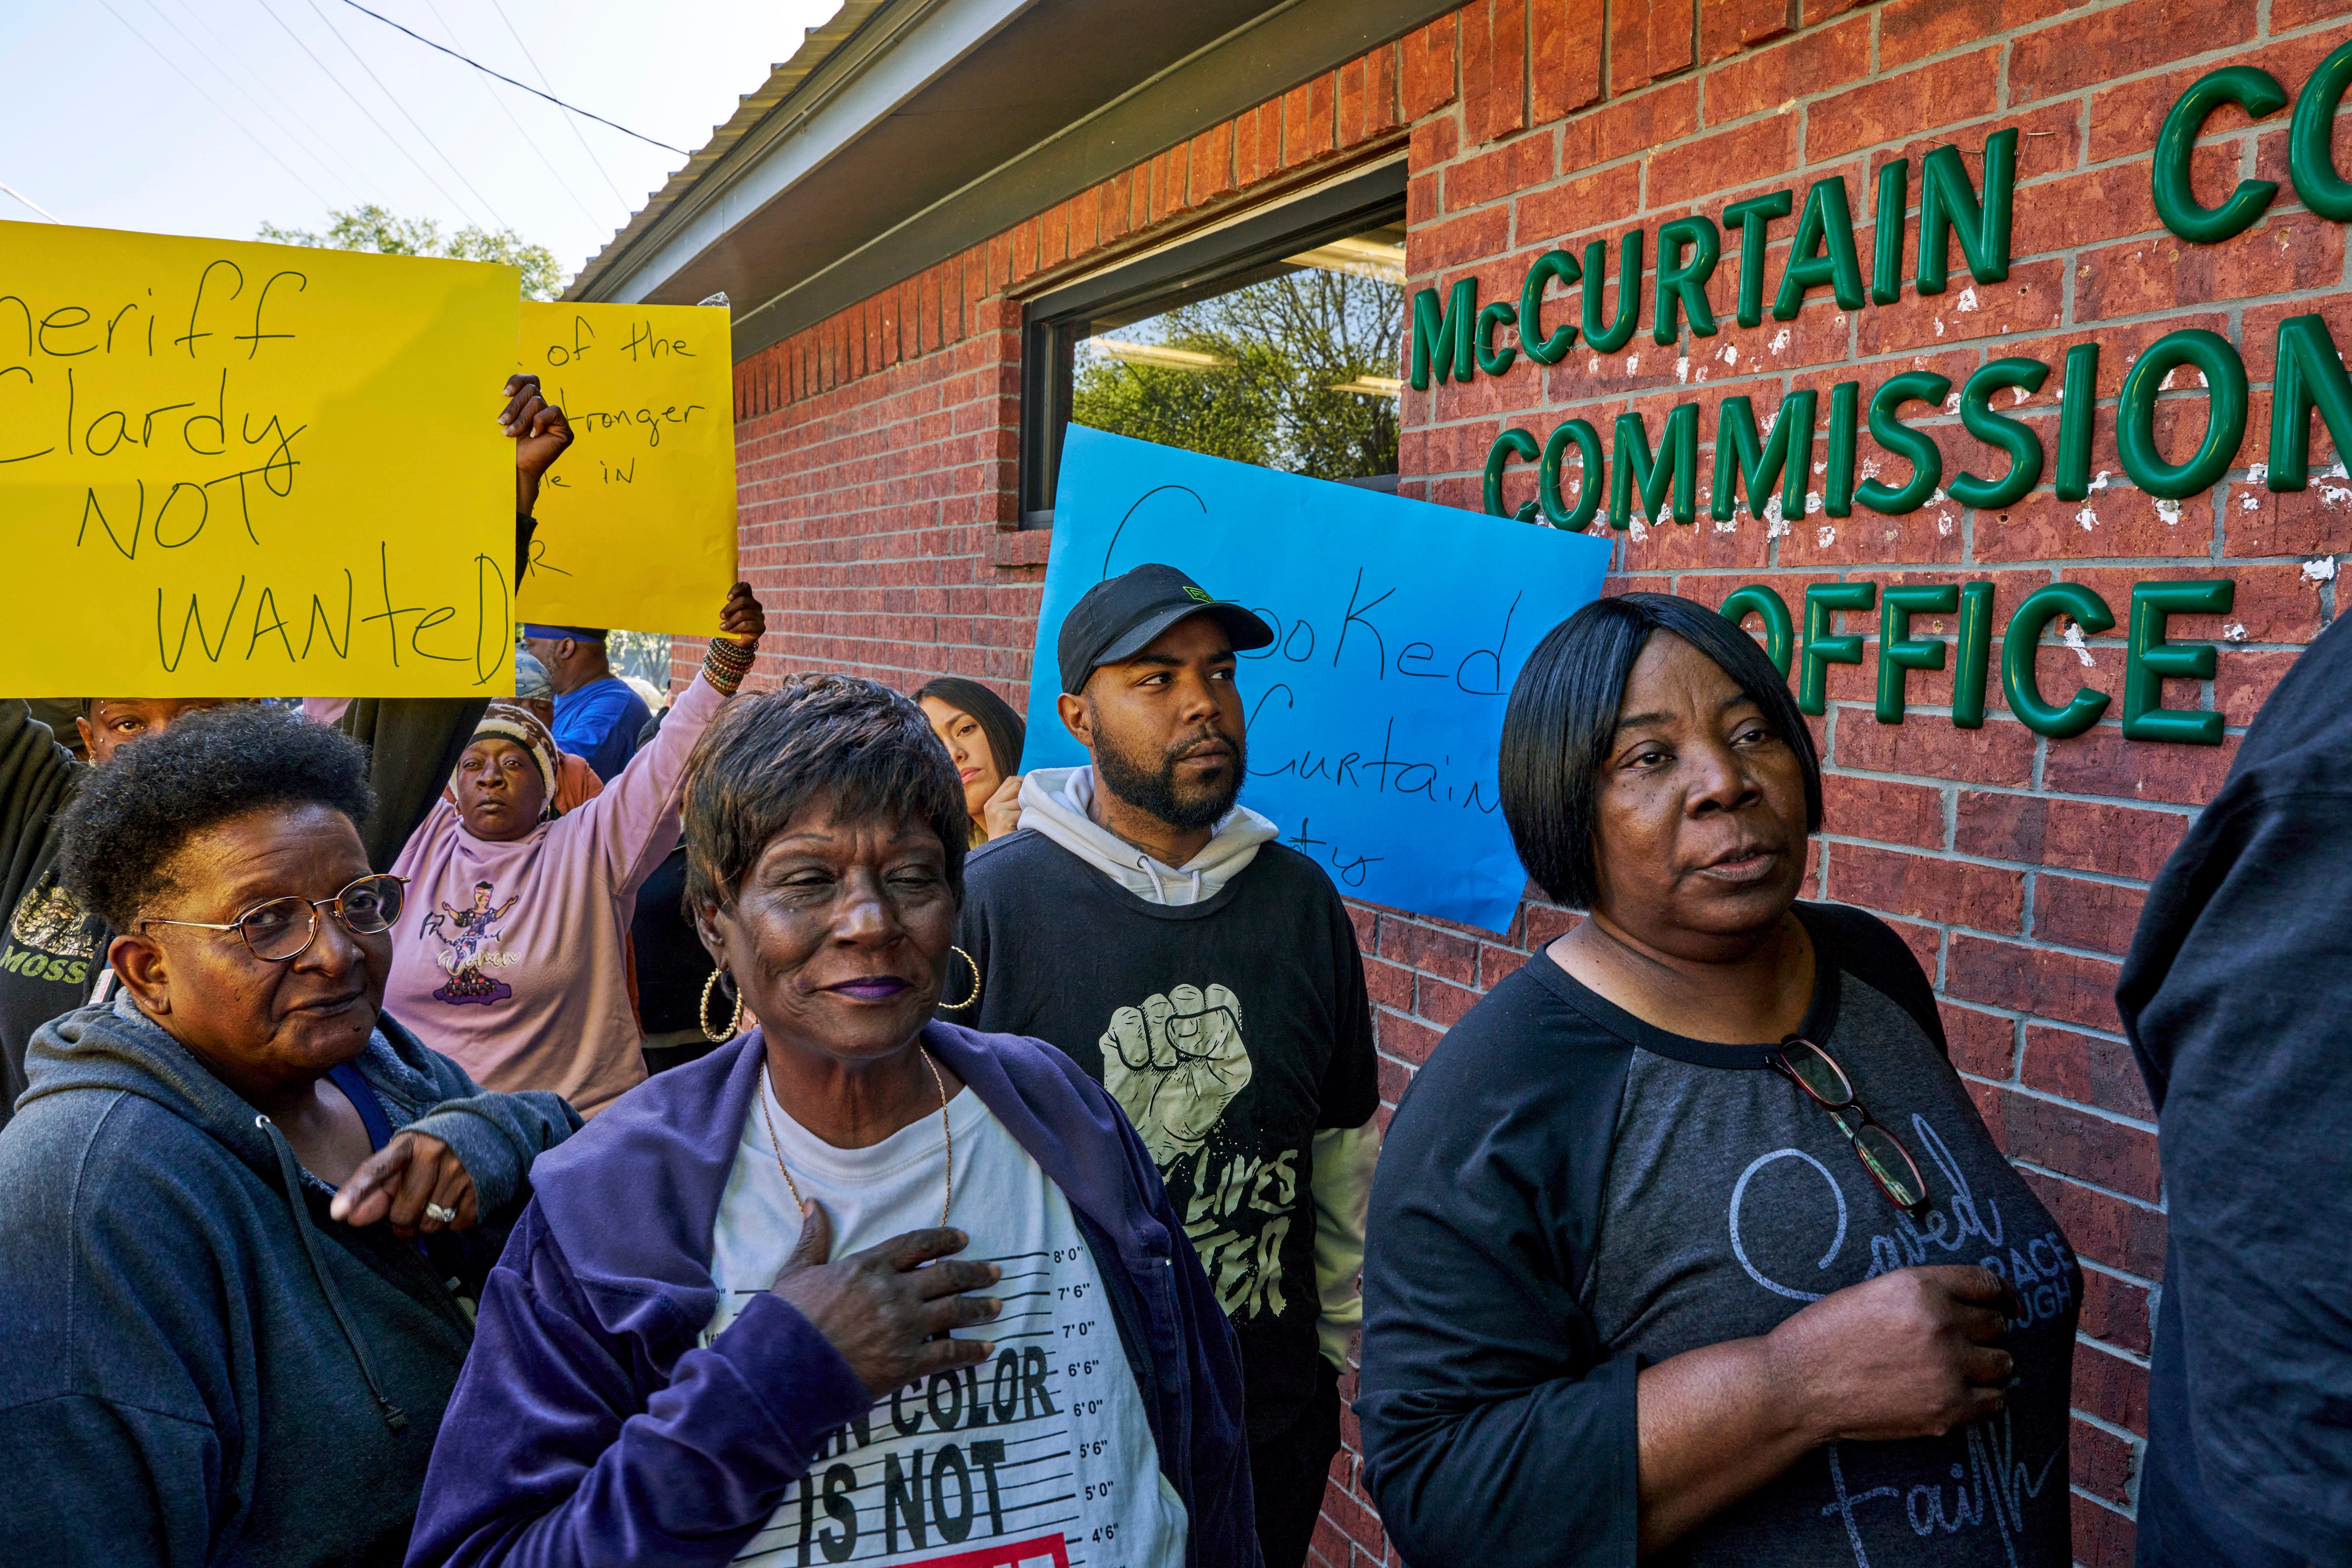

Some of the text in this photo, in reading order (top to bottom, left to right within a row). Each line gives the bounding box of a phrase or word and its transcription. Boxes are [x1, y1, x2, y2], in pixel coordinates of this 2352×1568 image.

[547, 315, 697, 366] of the
[560, 387, 705, 447] tronger
[1484, 313, 2352, 533] COMMISSION
[77, 461, 301, 560] NOT
[1717, 579, 2235, 744] OFFICE
[1287, 817, 1384, 887] ty
[0, 945, 89, 984] MOSS
[437, 949, 522, 978] Women
[1185, 1146, 1298, 1224] LIVES
[2008, 1276, 2072, 1331] UGH
[891, 1346, 1056, 1436] COLOR
[797, 1438, 1006, 1567] IS NOT
